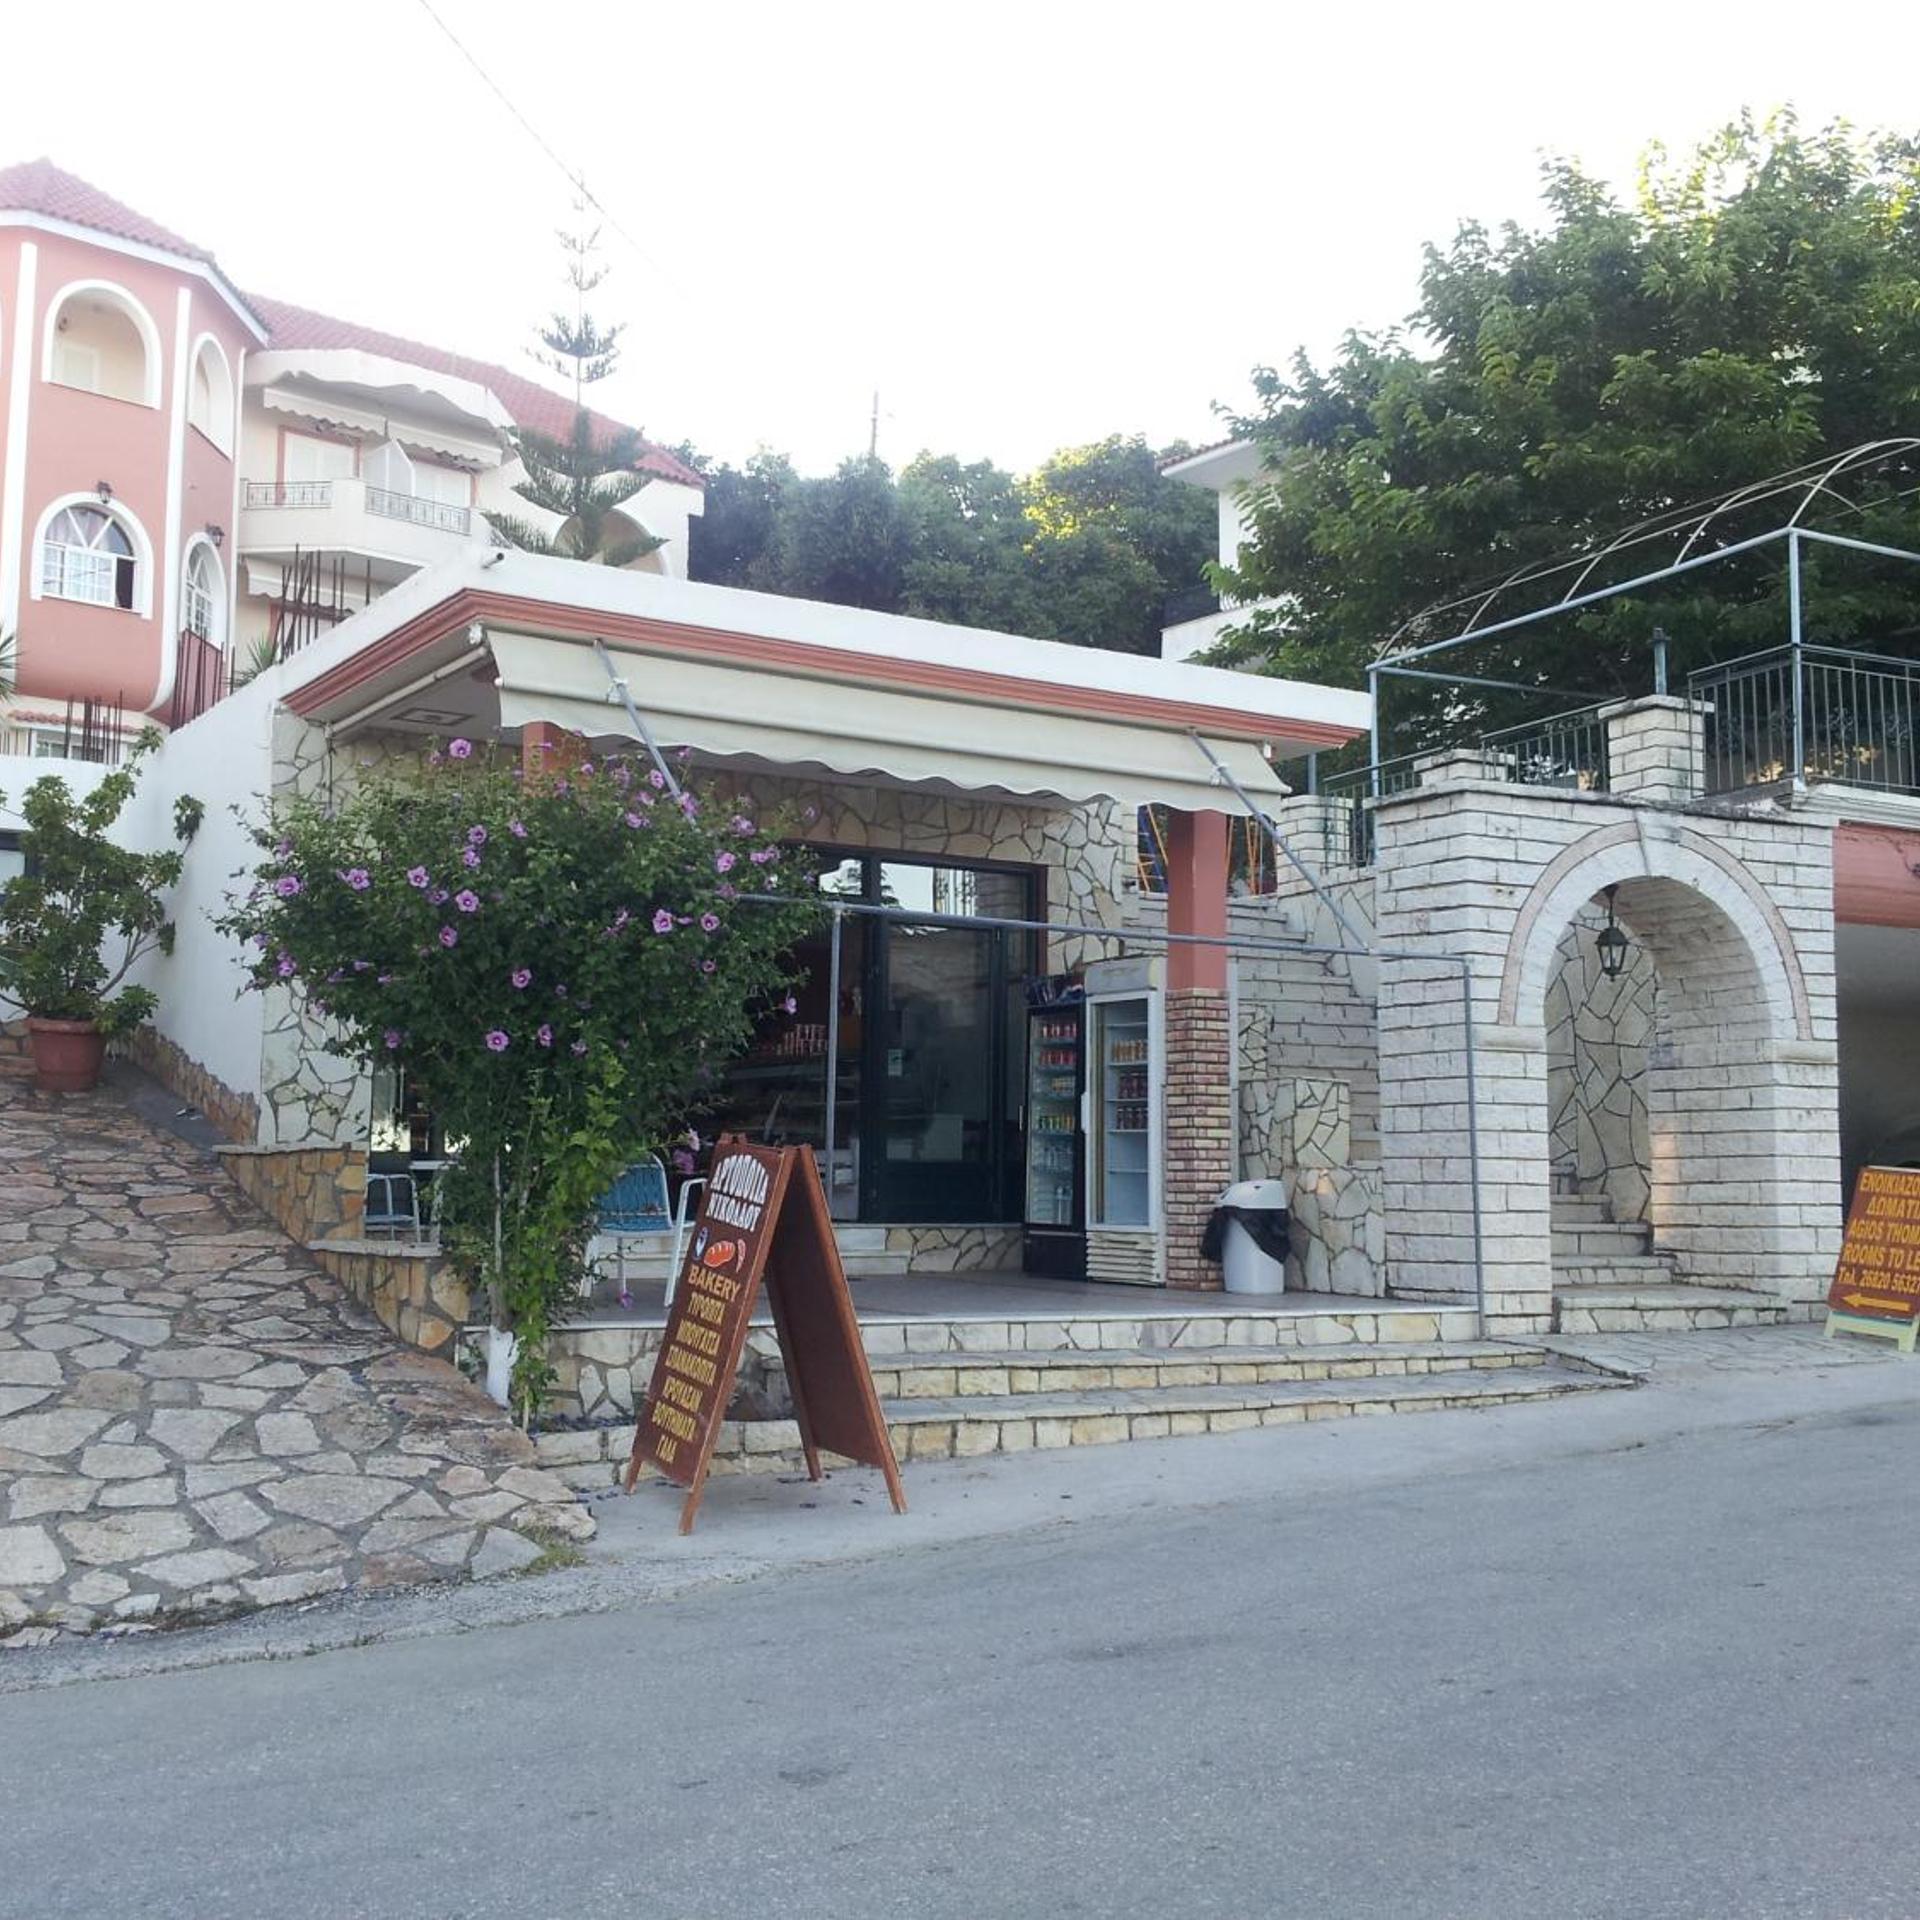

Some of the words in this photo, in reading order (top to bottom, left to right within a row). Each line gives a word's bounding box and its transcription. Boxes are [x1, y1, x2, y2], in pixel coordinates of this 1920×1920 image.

[1847, 1218, 1884, 1240] AGIOS
[1842, 1242, 1885, 1266] ROOMS
[1888, 1248, 1904, 1269] TO
[688, 1264, 741, 1302] BAKERY
